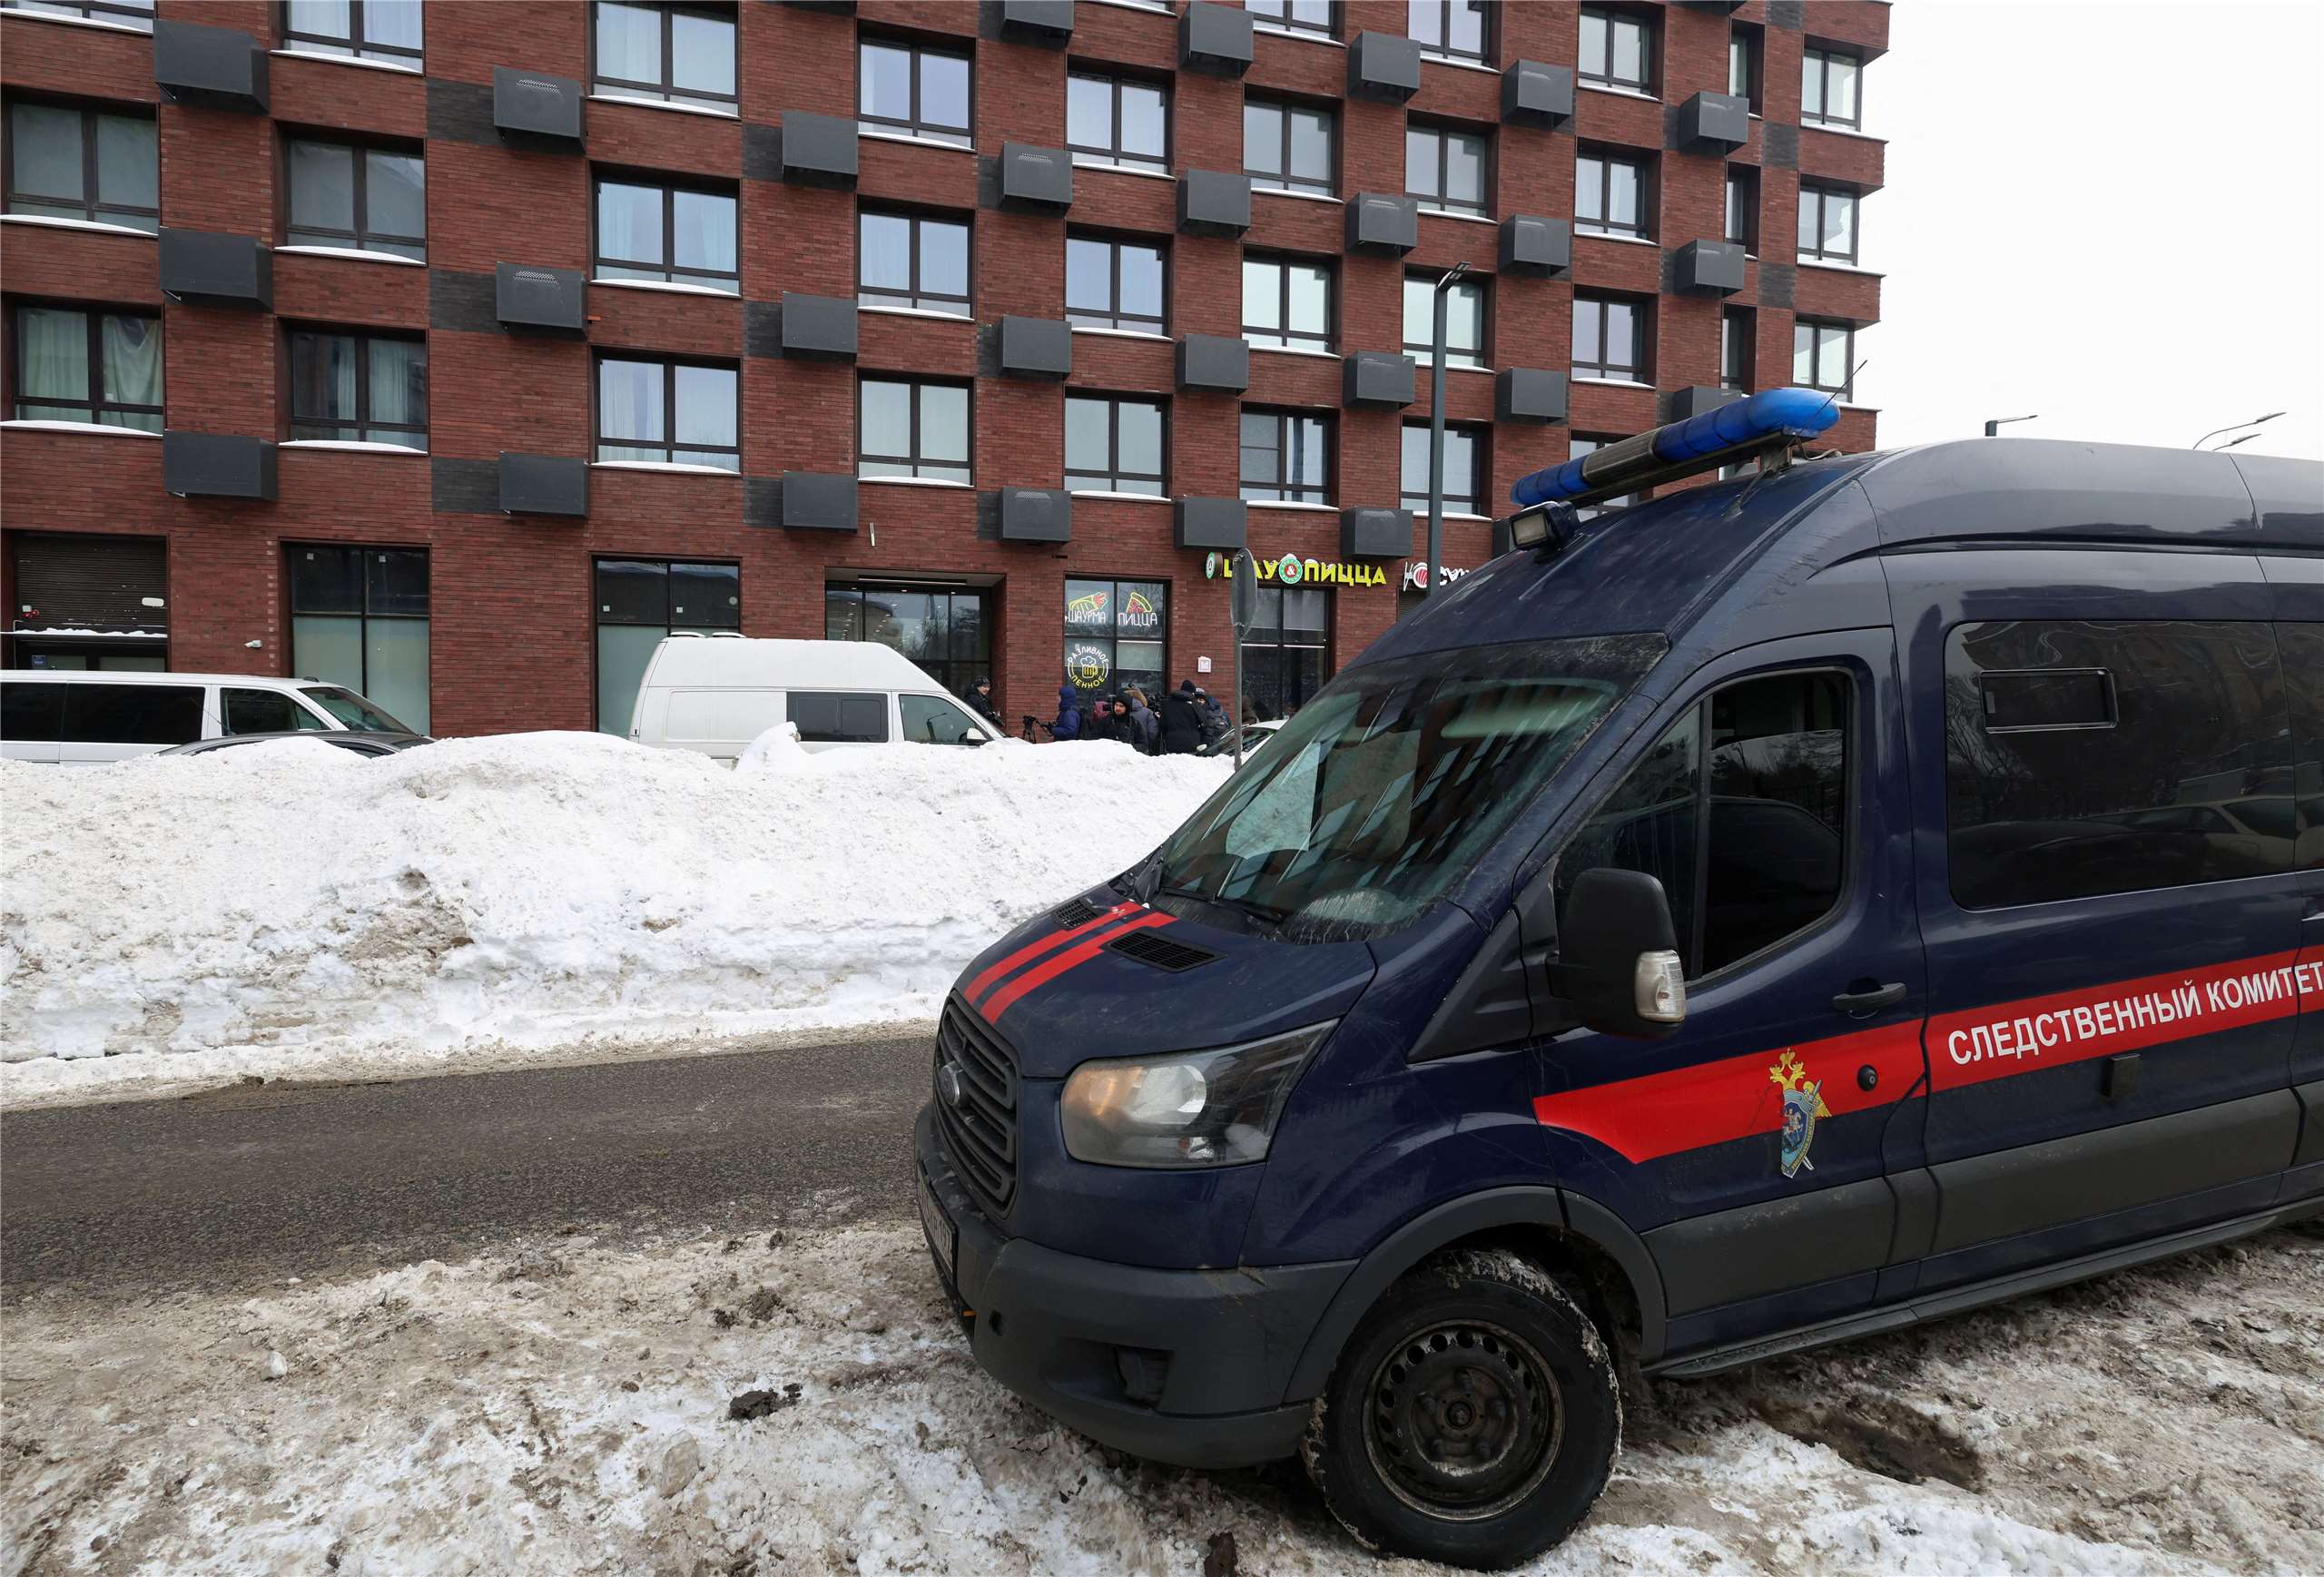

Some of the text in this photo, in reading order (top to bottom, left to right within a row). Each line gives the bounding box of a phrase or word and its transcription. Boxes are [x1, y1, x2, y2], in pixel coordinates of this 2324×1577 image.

[1304, 559, 1387, 587] ПИЦЦА
[1068, 610, 1106, 624] ШАУРМА
[1118, 612, 1157, 627] ПИЦЦА
[1068, 646, 1109, 664] РАЗЛИВНОЕ
[1071, 675, 1105, 689] ПЕННОЕ
[1948, 961, 2323, 1065] СЛЕДСТВЕННЫЙ КОМИТЕТ
